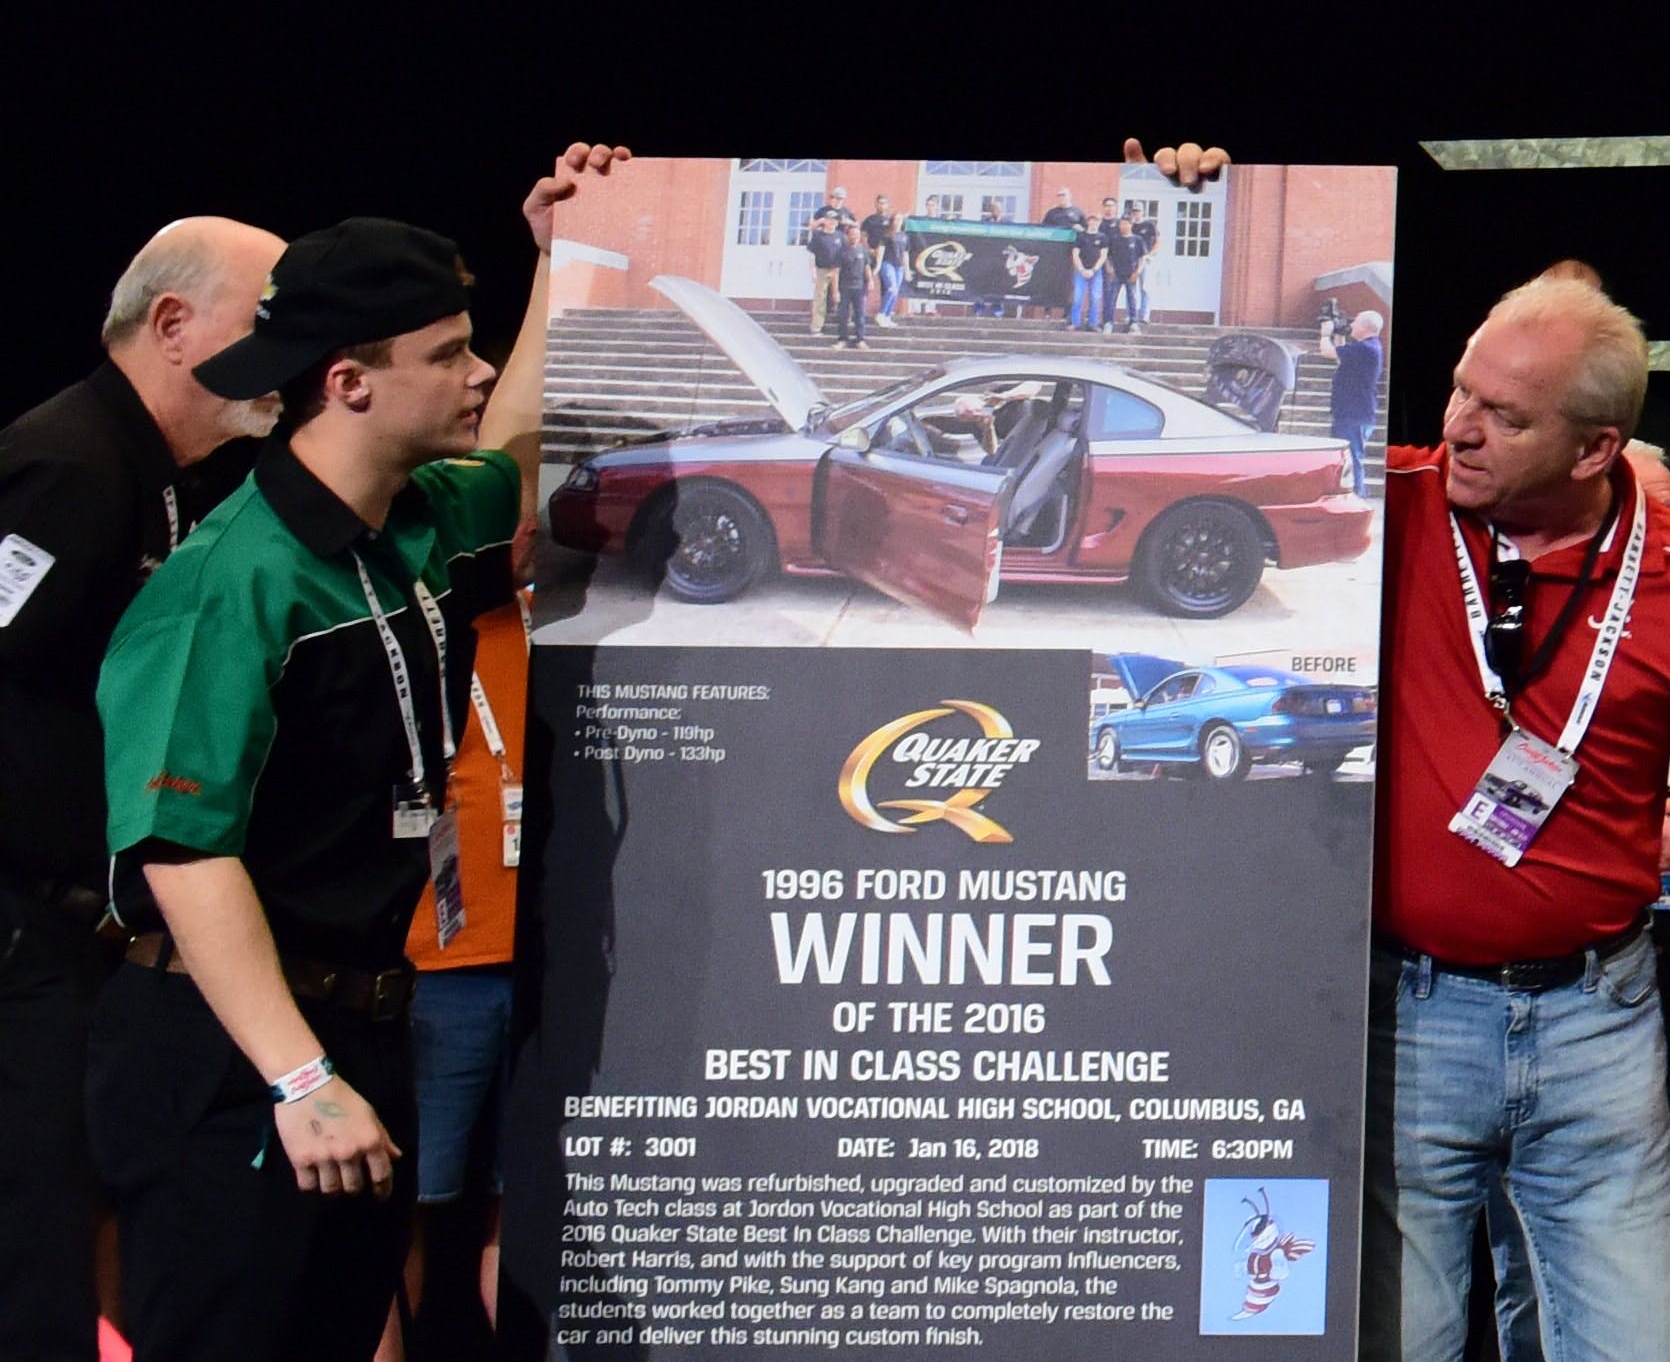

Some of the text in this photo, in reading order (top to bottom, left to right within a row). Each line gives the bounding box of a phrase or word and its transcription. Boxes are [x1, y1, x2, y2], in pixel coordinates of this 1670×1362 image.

[1291, 656, 1357, 673] BEFORE
[578, 684, 770, 700] THIS MUSTANG FEATURES:
[576, 704, 682, 720] Performance:
[585, 724, 658, 743] Pre-Dyno
[673, 725, 715, 744] 119hp
[584, 746, 620, 761] Post
[623, 745, 665, 764] Dyno
[680, 746, 726, 764] 133hp
[892, 732, 1041, 763] QUAKER
[904, 763, 1014, 788] STATE
[1470, 801, 1487, 822] E
[762, 869, 1126, 902] 1996 FORD MUSTANG
[770, 912, 1113, 986] WINNER
[833, 1001, 1046, 1034] OF THE 2016
[705, 1049, 1170, 1082] BEST IN CLASS CHALLENGE
[564, 1096, 1306, 1123] BENEFITING JORDAN VOCATIONAL HIGH SCHOOL, COLUMBUS, GA
[565, 1136, 696, 1157] LOT #: 3001
[837, 1138, 1039, 1160] DATE: Jan 16, 2018
[1142, 1139, 1294, 1160] TIME: 6:30PM
[565, 1172, 1194, 1198] This Mustang was refurbished, upgraded and customized by the
[563, 1198, 1183, 1222] Auto Tech class at Jordon Vocational High School as part of the
[562, 1224, 606, 1243] 2016
[611, 1224, 682, 1244] Quaker
[686, 1224, 738, 1243] State
[743, 1225, 788, 1243] Best
[817, 1224, 871, 1244] Class
[876, 1224, 976, 1248] Challenge.
[982, 1225, 1026, 1244] With
[1032, 1225, 1078, 1244] their
[1083, 1226, 1184, 1246] instructor,
[561, 1250, 626, 1268] Robert
[632, 1250, 695, 1270] Harris,
[700, 1249, 738, 1268] and
[744, 1250, 786, 1268] with
[792, 1250, 825, 1269] the
[830, 1252, 907, 1272] support
[912, 1250, 934, 1269] of
[938, 1250, 974, 1273] key
[978, 1254, 1062, 1273] program
[560, 1274, 1118, 1299] including Tommy Pike, Sung Kang and Mike Spagnola, the
